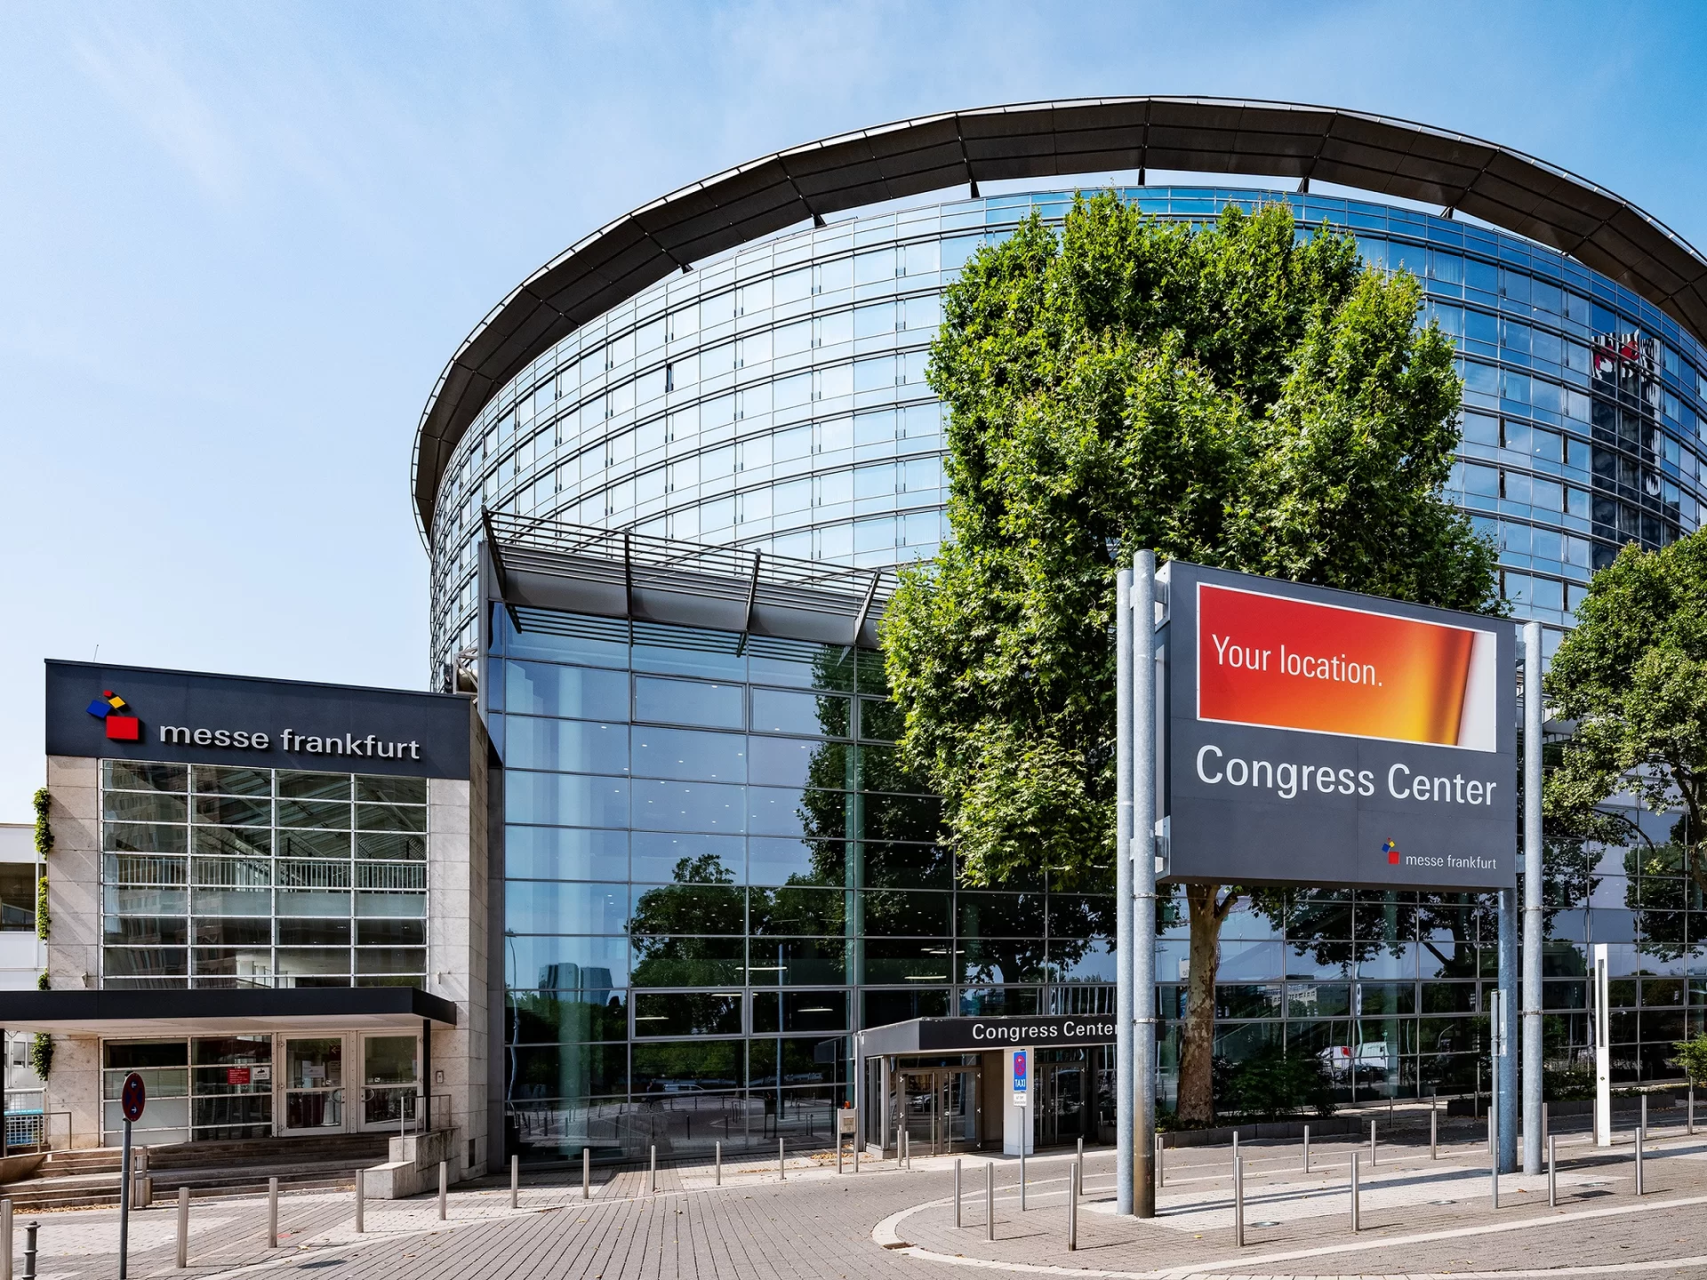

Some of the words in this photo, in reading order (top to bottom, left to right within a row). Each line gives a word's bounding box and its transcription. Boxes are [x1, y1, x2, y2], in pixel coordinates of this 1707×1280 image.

[1211, 634, 1271, 672] Your
[1280, 645, 1383, 687] location.
[159, 725, 270, 750] messe
[280, 728, 421, 760] frankfurt
[1196, 745, 1376, 799] Congress
[1388, 763, 1497, 806] Center
[1405, 853, 1444, 868] messe
[1447, 854, 1497, 870] frankfurt
[972, 1023, 1058, 1042] Congress
[1014, 1078, 1026, 1088] TAXI
